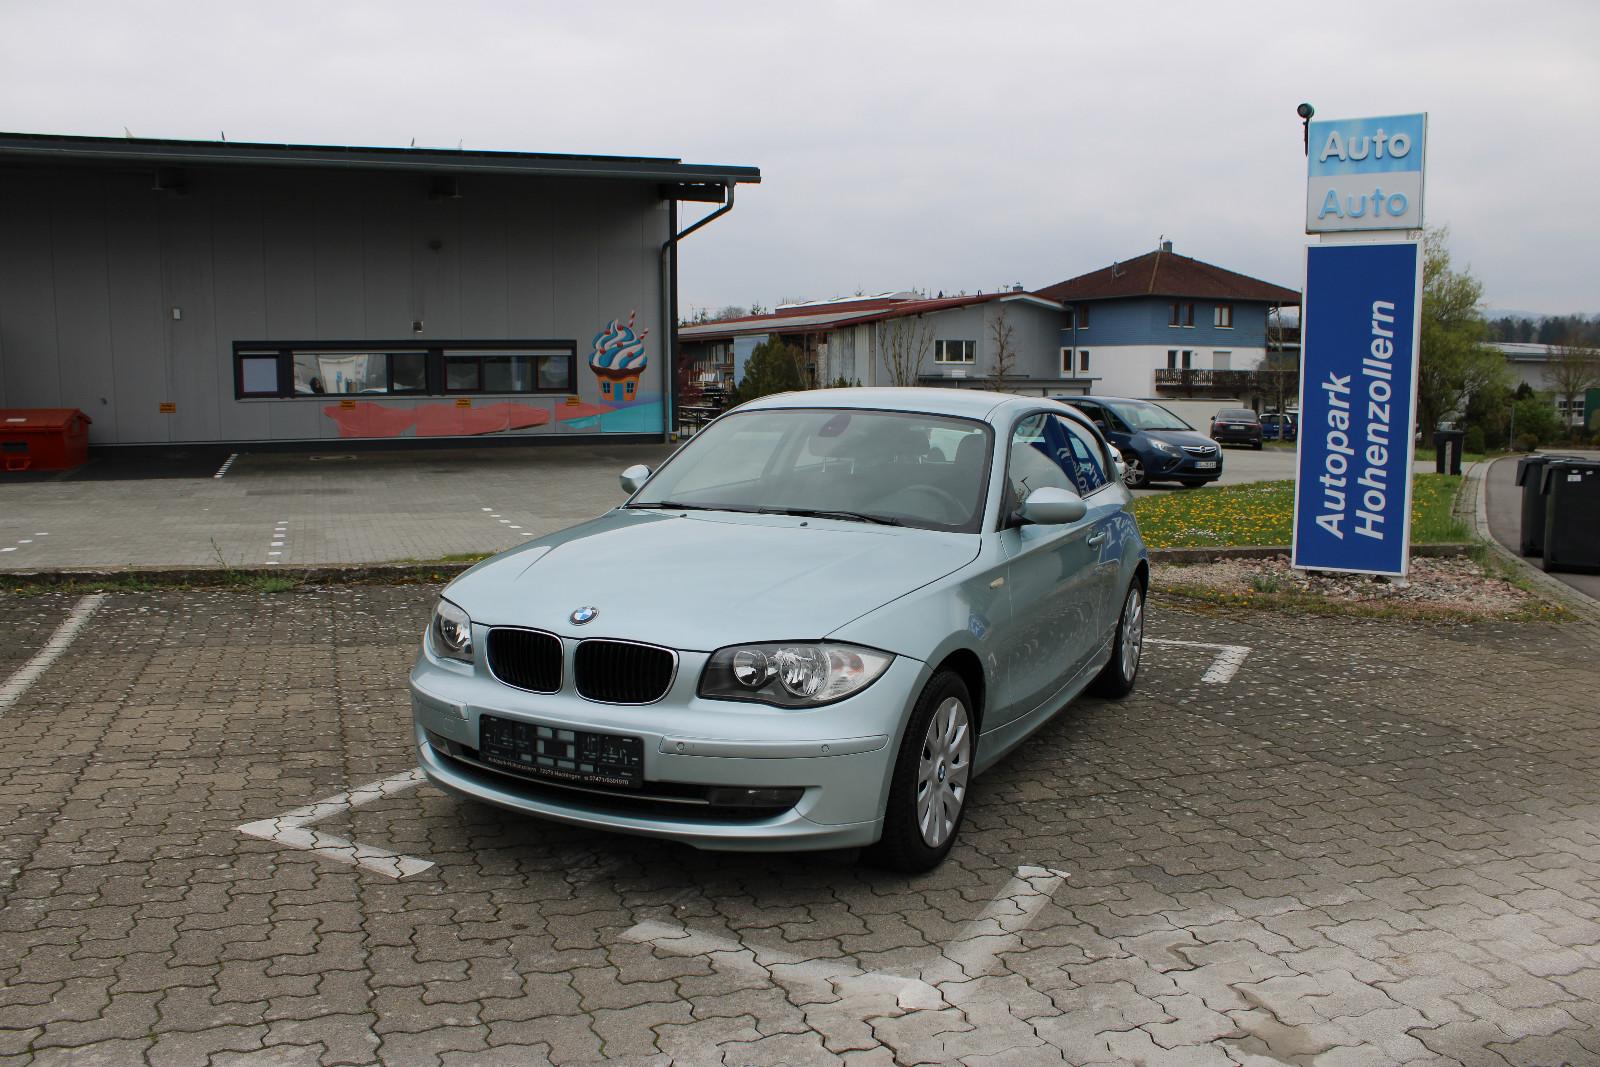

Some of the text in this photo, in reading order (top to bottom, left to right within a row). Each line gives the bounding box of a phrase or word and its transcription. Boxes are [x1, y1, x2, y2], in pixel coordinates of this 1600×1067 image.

[1320, 128, 1411, 163] Auto
[1318, 186, 1409, 219] Auto
[1315, 371, 1354, 540] Autopark
[1355, 300, 1395, 540] Hohenzollern
